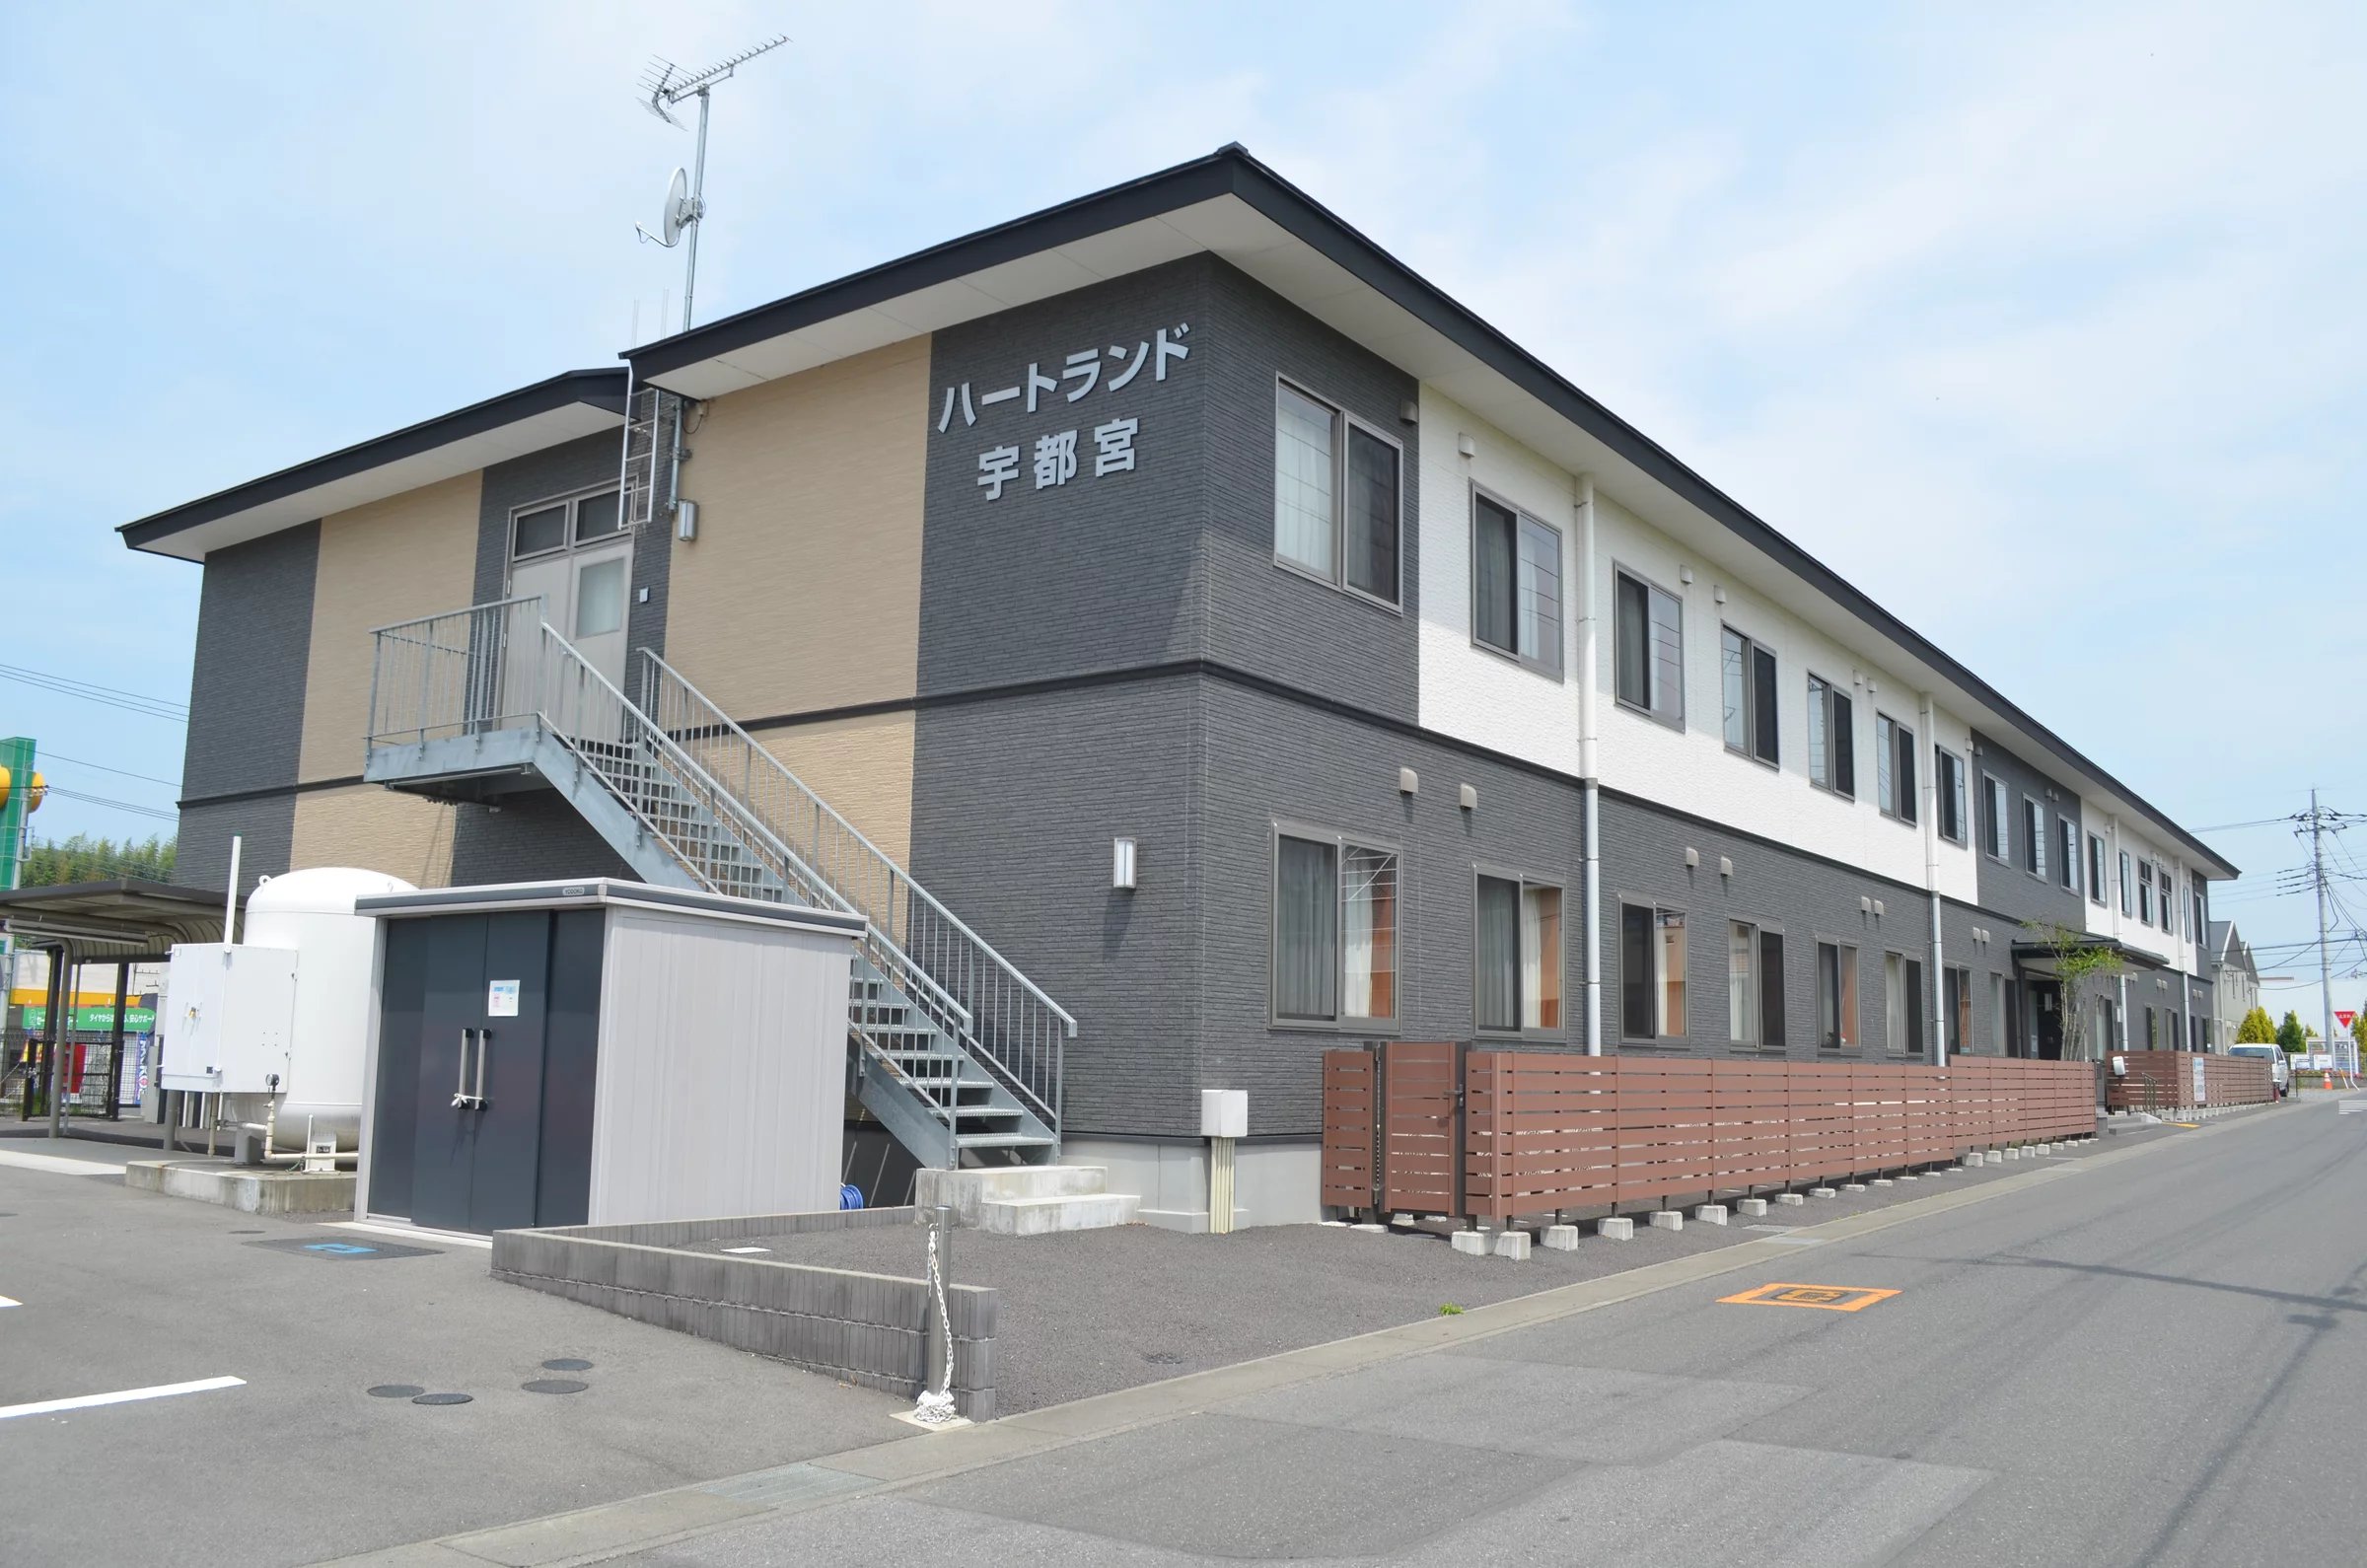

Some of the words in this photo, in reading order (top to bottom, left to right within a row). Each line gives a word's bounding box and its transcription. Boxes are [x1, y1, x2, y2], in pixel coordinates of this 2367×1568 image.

[938, 322, 1189, 433] ハートランド
[977, 418, 1138, 500] 宇都宮
